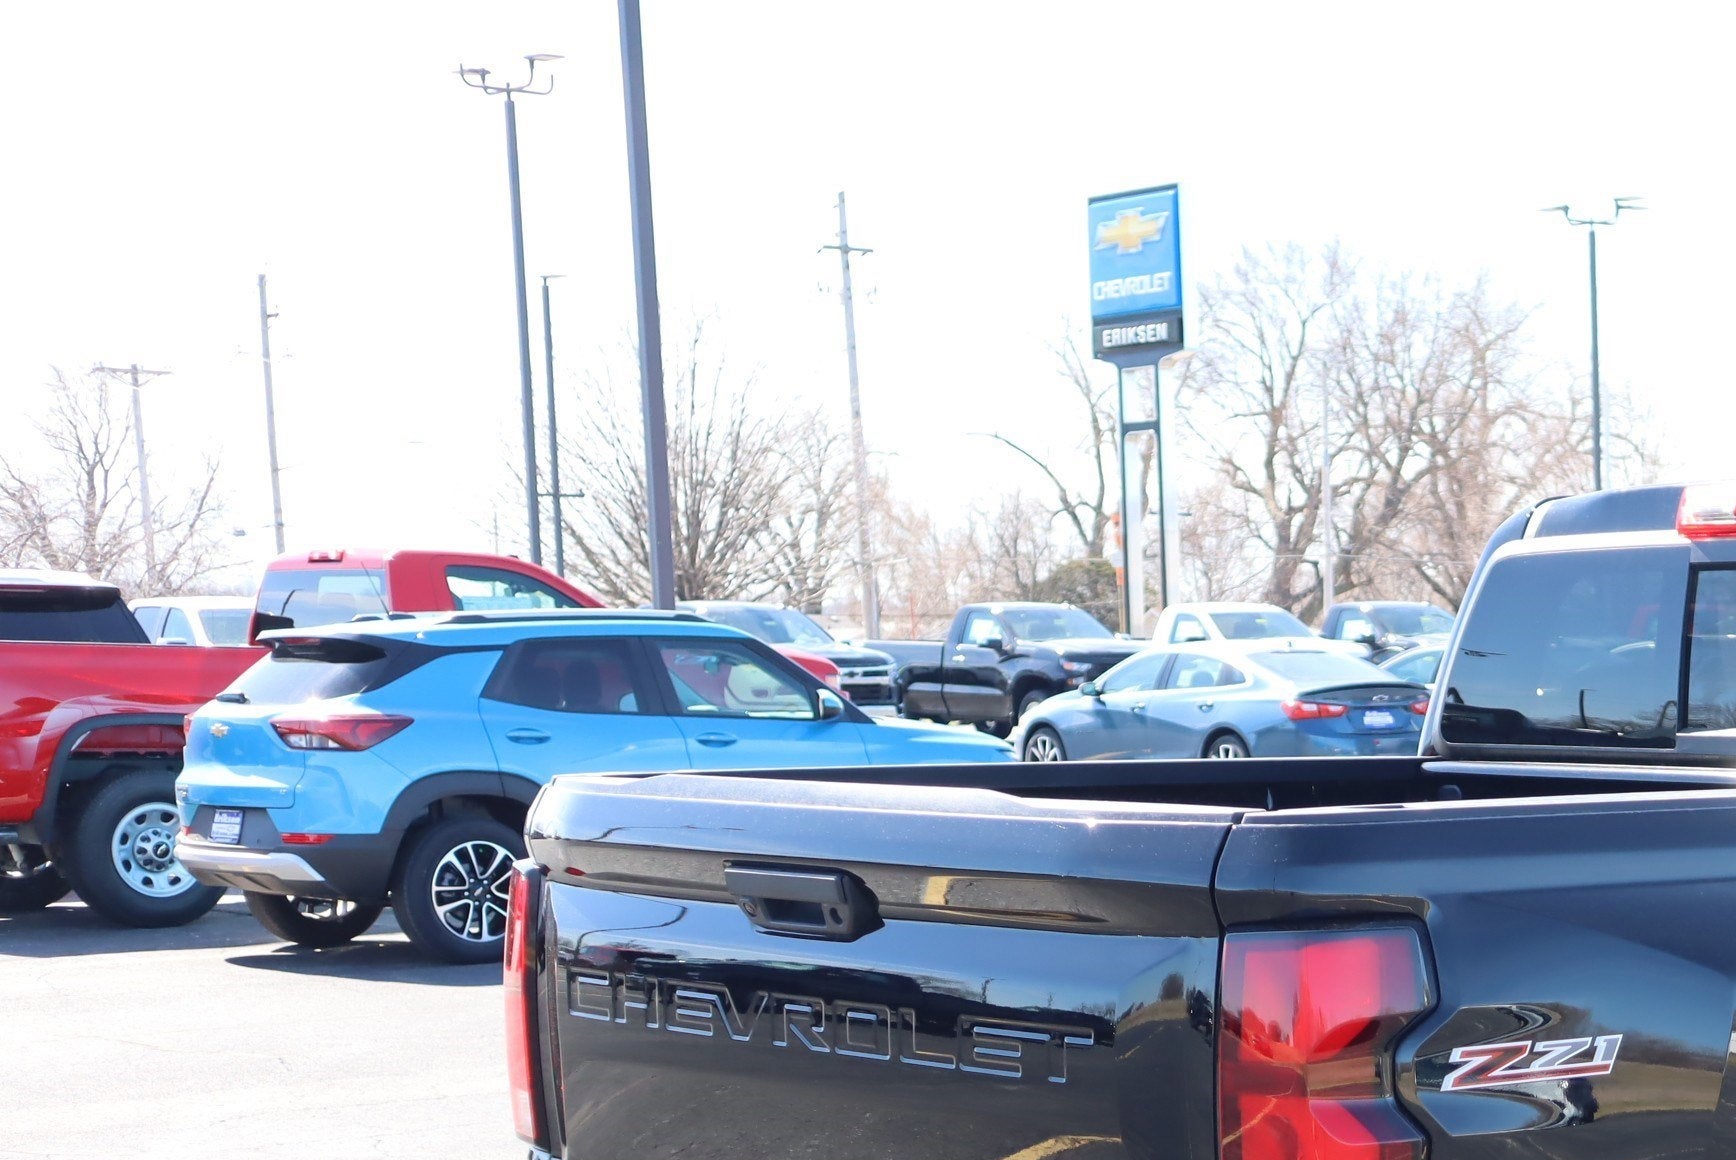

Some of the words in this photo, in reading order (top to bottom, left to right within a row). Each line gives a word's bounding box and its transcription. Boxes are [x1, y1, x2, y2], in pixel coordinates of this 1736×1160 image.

[1092, 271, 1172, 300] CHEVROLET
[1102, 322, 1169, 348] ERIKSEN
[567, 966, 1094, 1083] CHEVROLET
[1440, 1034, 1623, 1092] Z71
